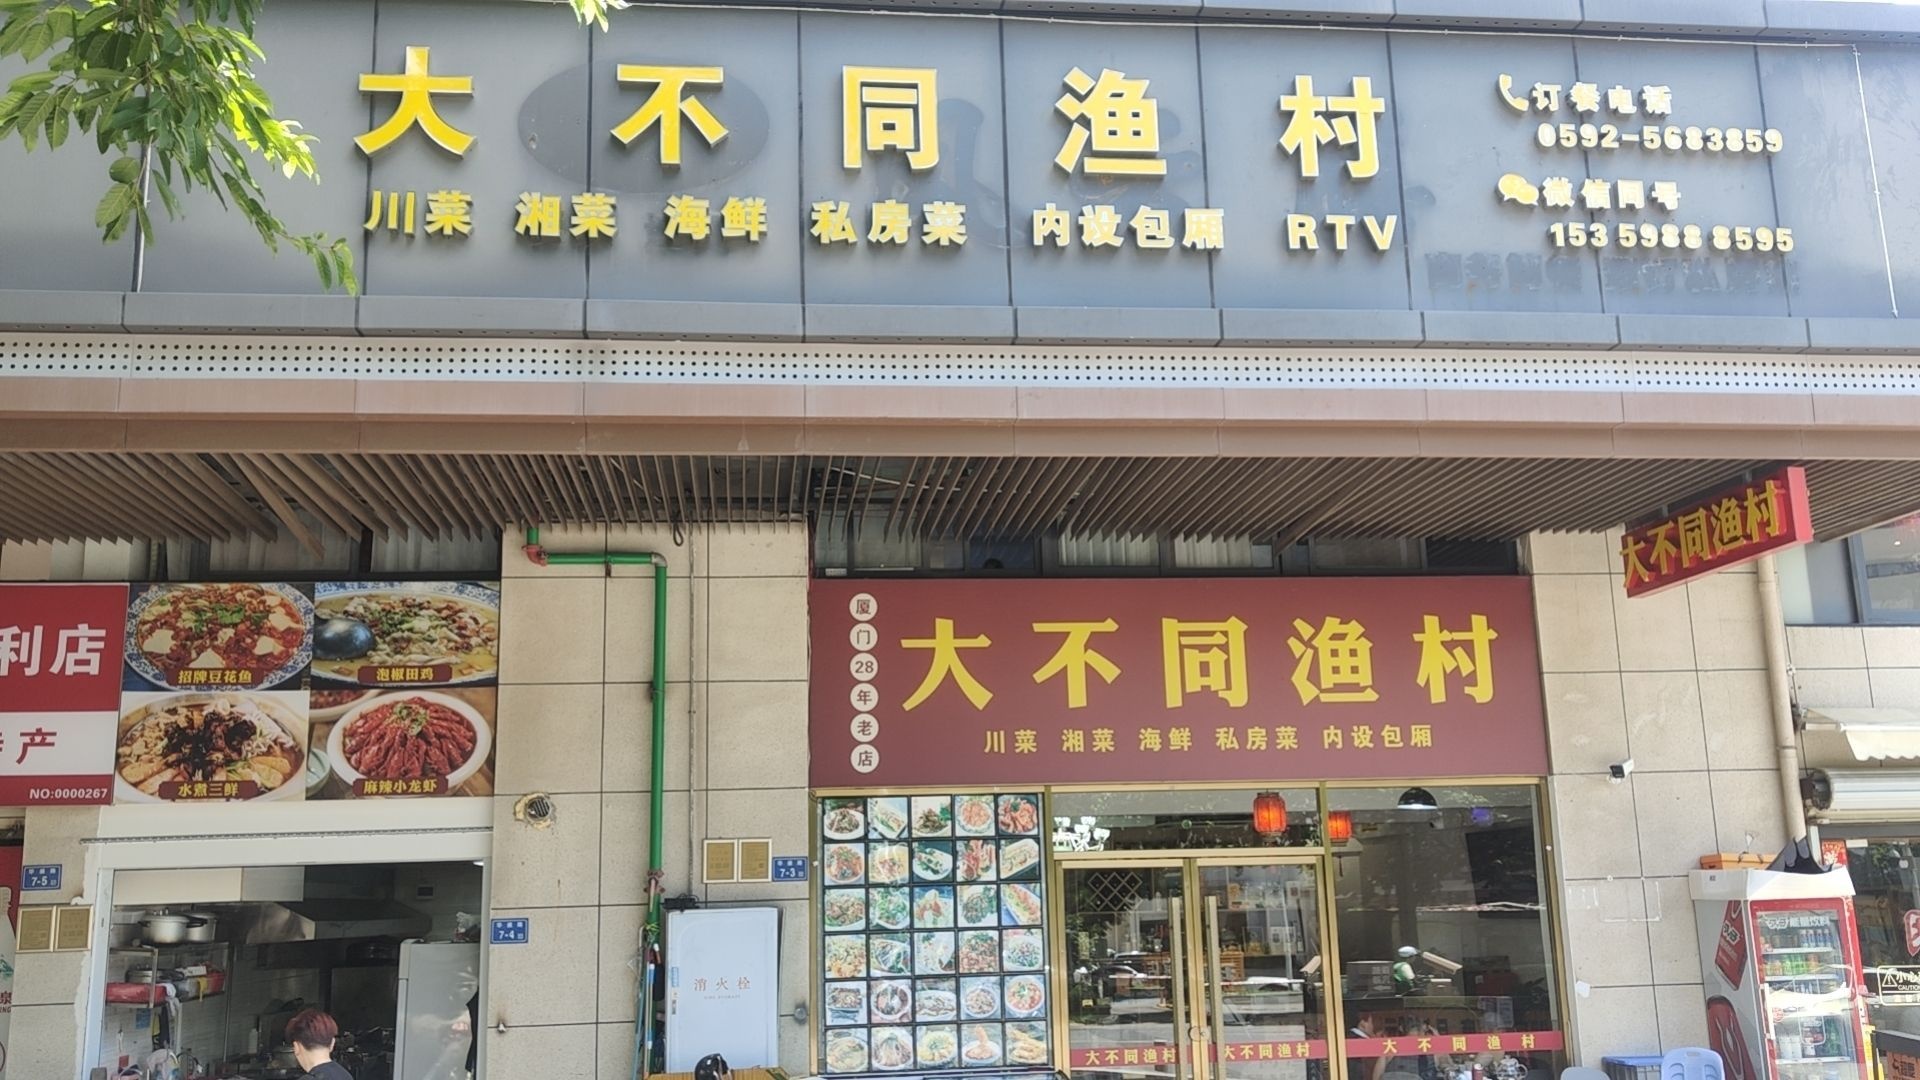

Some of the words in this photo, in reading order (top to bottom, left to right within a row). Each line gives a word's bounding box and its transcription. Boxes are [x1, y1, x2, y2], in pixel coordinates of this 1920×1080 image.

[354, 46, 1387, 180] 大不同渔村
[1531, 82, 1673, 115] 订餐电话
[1536, 123, 1784, 153] 0592-5683859
[1542, 176, 1681, 211] 微信同号
[364, 190, 474, 238] 川菜
[515, 191, 618, 240] 湘菜
[664, 194, 769, 242] 海鲜
[810, 199, 969, 246] 私房菜
[1033, 203, 1225, 251] 内设包厢
[1286, 213, 1398, 251] RTV
[1549, 221, 1609, 248] 153
[1618, 222, 1703, 250] 5988
[1711, 224, 1794, 252] 8595
[1620, 479, 1785, 588] 大不同渔村
[0, 624, 107, 677] 利店
[900, 614, 1498, 712] 大不同渔村
[178, 669, 252, 684] 招牌豆花鱼
[376, 667, 434, 681] 泡椒田鸡
[855, 599, 875, 767] 厦门28年老店
[0, 727, 57, 765] 产
[984, 729, 1038, 754] 川菜
[1061, 728, 1115, 753] 湘菜
[1139, 727, 1193, 752] 海鲜
[1215, 726, 1299, 751] 私房菜
[1322, 723, 1435, 750] 内设包厢
[29, 788, 108, 799] NO:0000267
[178, 782, 239, 797] 水煮三鲜
[363, 778, 438, 794] 麻辣小龙虾
[694, 977, 751, 992] 消火栓
[1085, 1047, 1177, 1065] 大不同渔村
[1224, 1042, 1311, 1060] 大不同渔村
[1383, 1034, 1535, 1054] 大不同渔村
